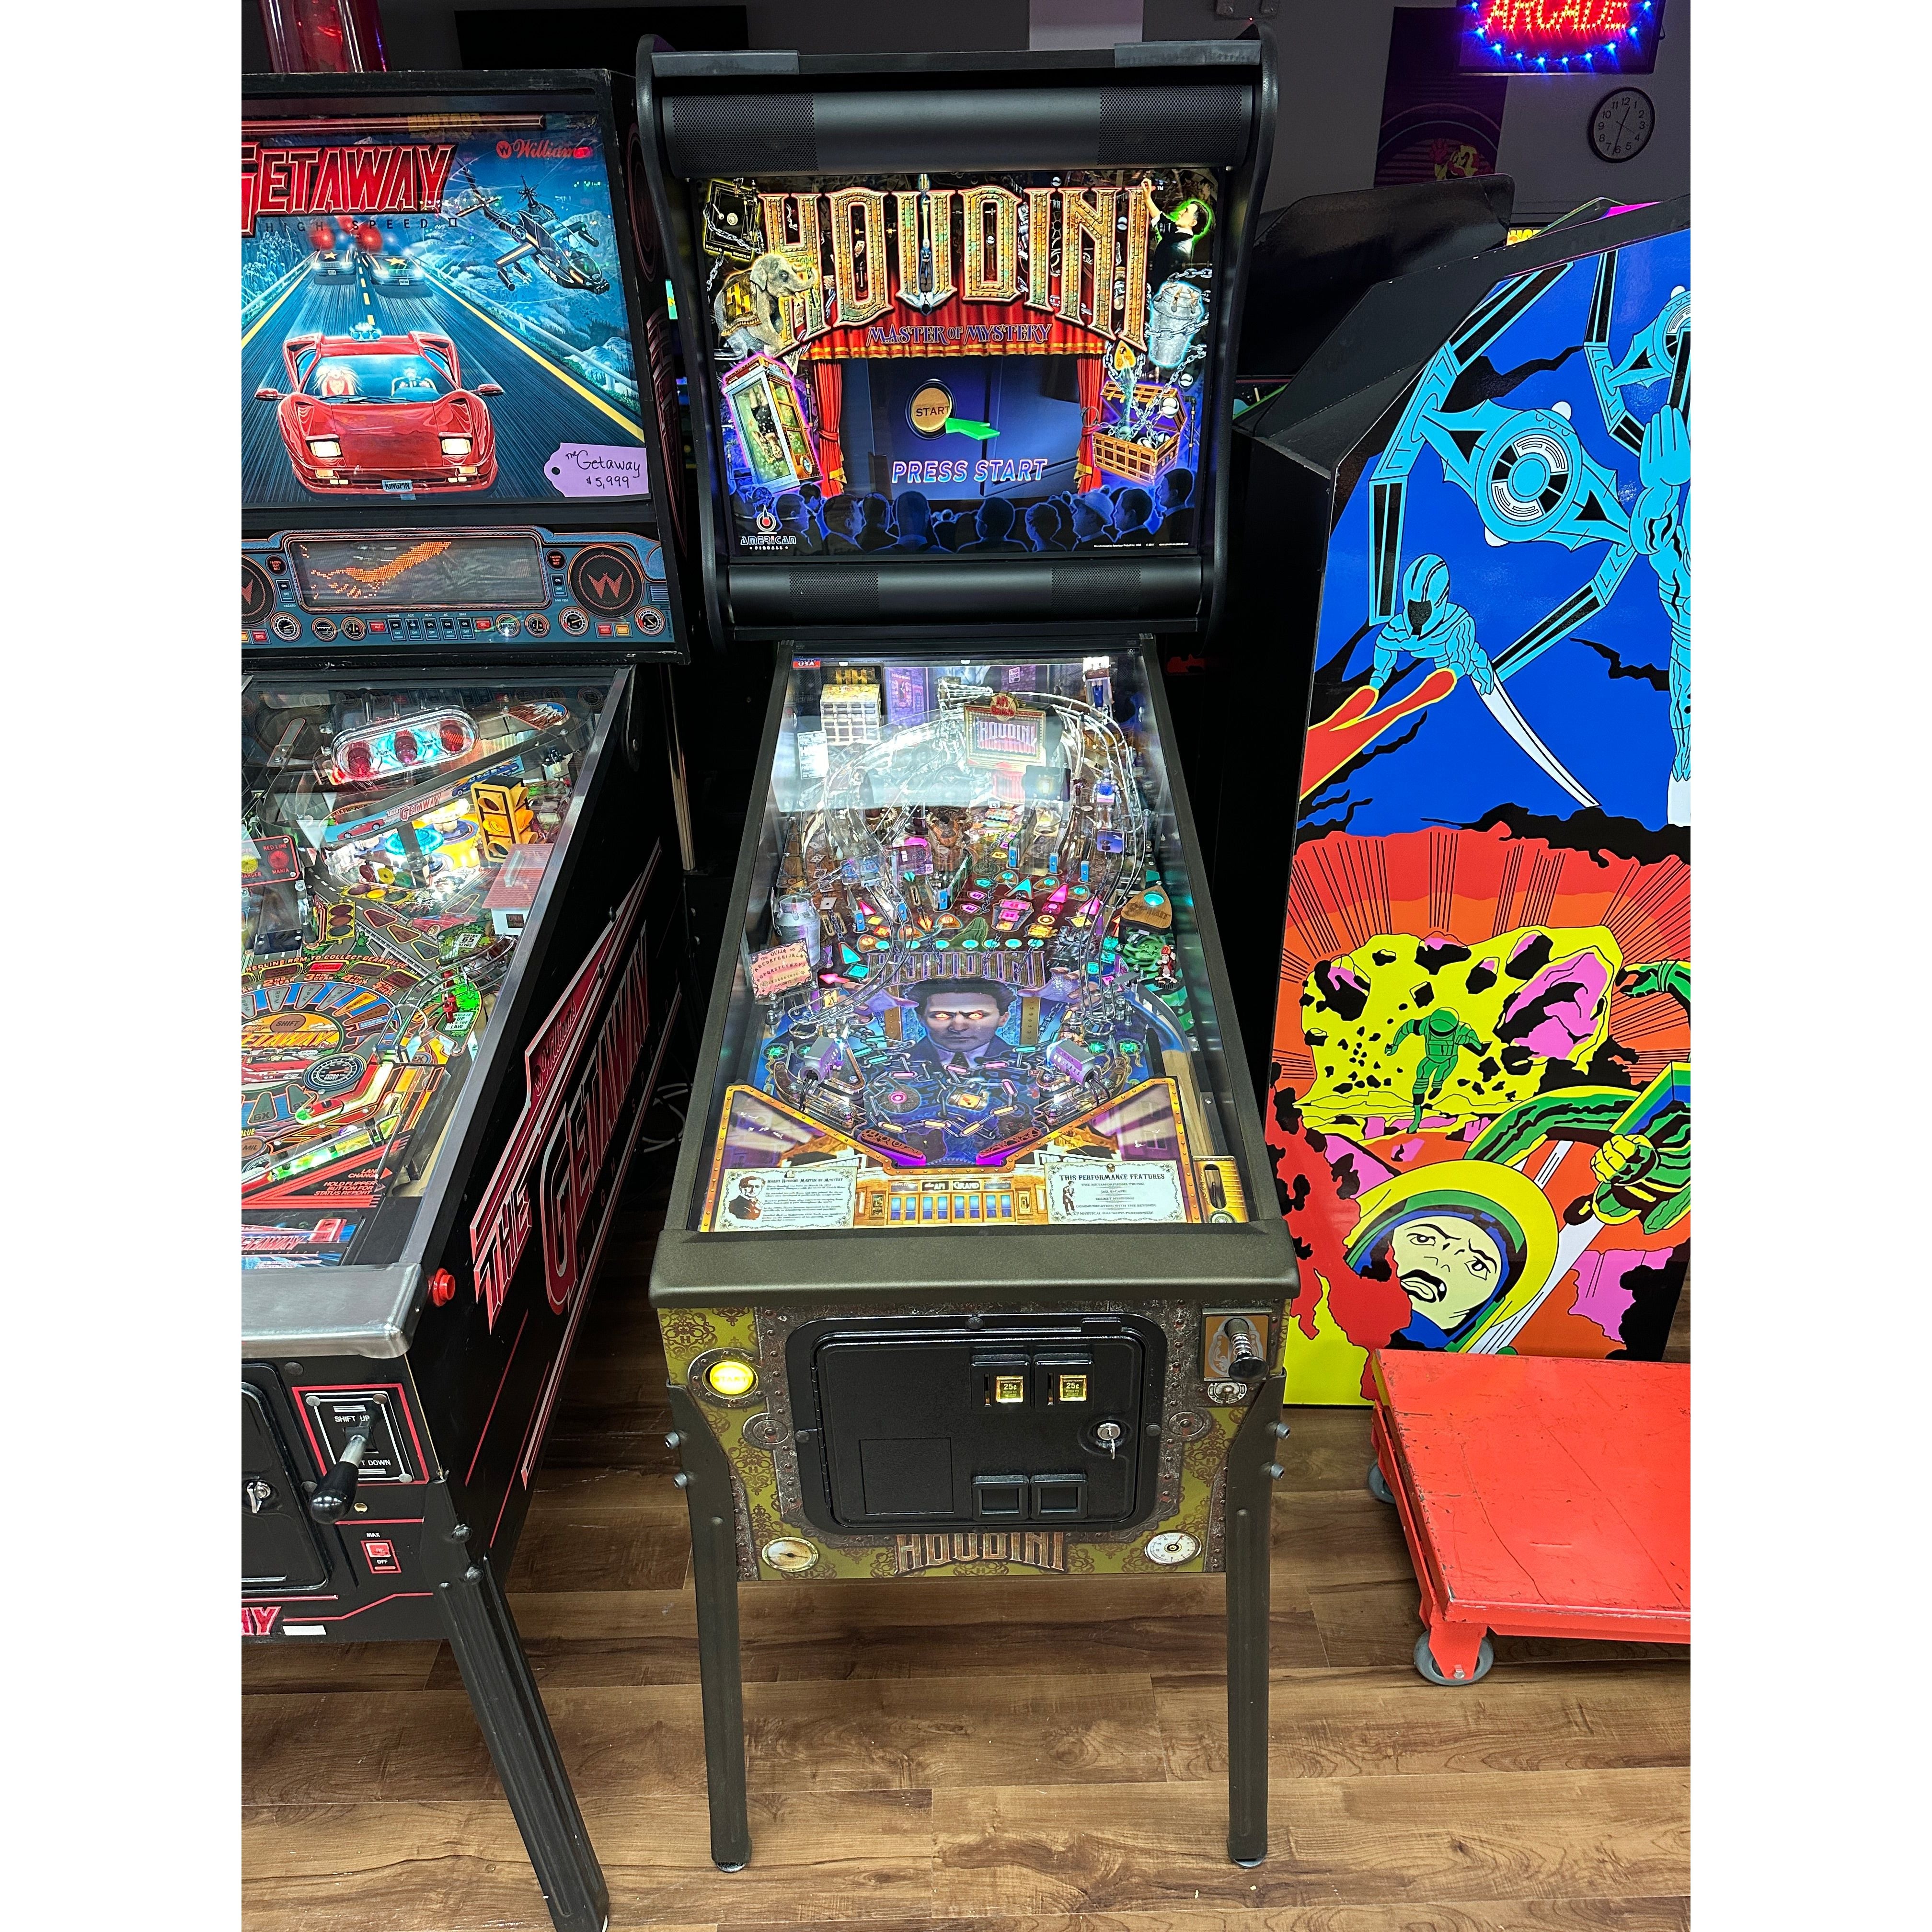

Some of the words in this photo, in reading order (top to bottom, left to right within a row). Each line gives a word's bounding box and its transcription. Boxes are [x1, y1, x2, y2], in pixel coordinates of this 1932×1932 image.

[1612, 101, 1619, 109] 11
[1622, 97, 1630, 106] 12
[1603, 111, 1611, 119] 10
[1639, 110, 1644, 118] 2
[1640, 121, 1645, 129] 3
[1606, 142, 1611, 151] 7
[265, 221, 323, 233] HIGH
[352, 218, 428, 231] SPEED
[758, 185, 1149, 363] HOUDINI
[866, 323, 946, 347] MASTER
[946, 326, 965, 340] OF
[963, 323, 1053, 344] MYSTERY
[916, 406, 950, 417] START
[565, 451, 578, 460] The
[577, 449, 640, 478] Getaway
[892, 460, 968, 483] PRESS
[975, 459, 1048, 482] START
[384, 480, 411, 490] KINGPIN
[586, 476, 630, 489] $5,999
[740, 536, 797, 546] AMERICAN
[400, 793, 441, 821] GETAWAY
[246, 960, 285, 972] REDLINE
[385, 959, 408, 969] VALUE
[303, 988, 313, 1001] RPM
[359, 1009, 383, 1019] RPM
[253, 1112, 271, 1121] 6X
[541, 920, 650, 1314] GETAWAY
[474, 1180, 531, 1334] THE
[895, 1533, 1065, 1576] HOUDINI
